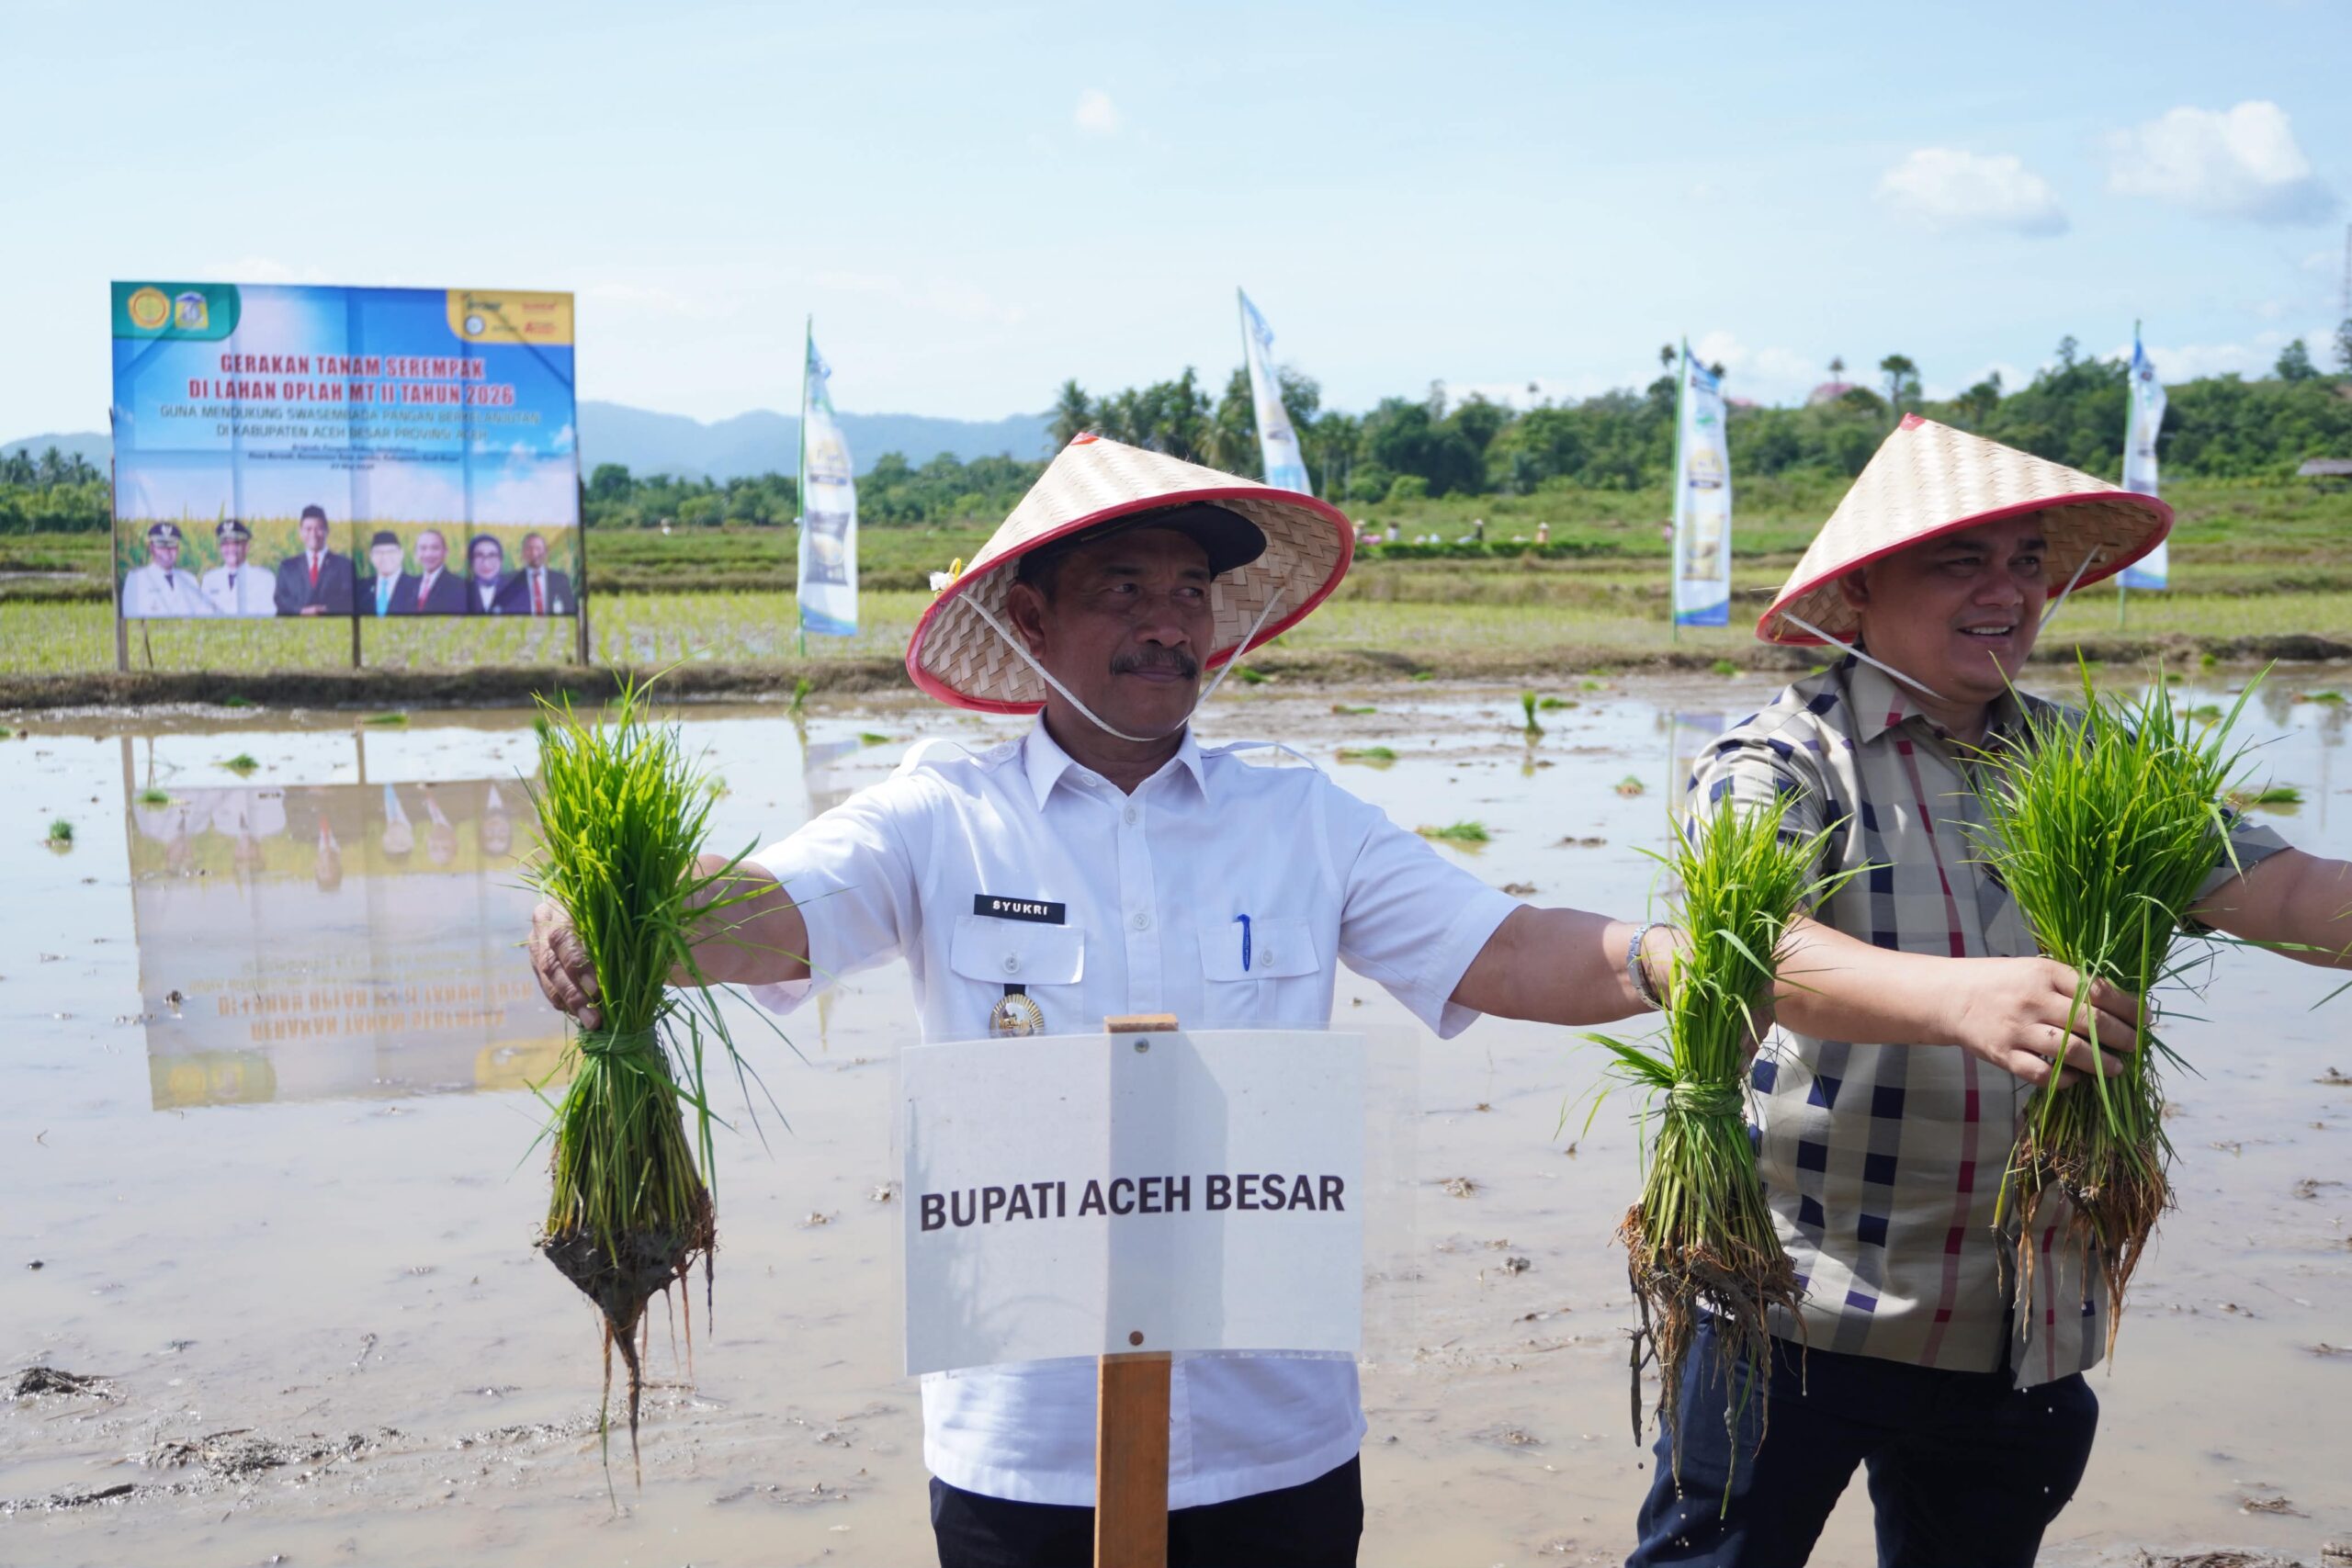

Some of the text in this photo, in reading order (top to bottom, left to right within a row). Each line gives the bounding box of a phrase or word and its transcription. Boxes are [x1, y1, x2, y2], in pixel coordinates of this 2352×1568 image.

[220, 354, 485, 378] GERAKAN TANAM SEREMPAK
[189, 378, 514, 405] DI LAHAN OPLAH MT II TAHUN 2026
[160, 404, 197, 418] GUNA
[201, 405, 283, 420] MENDUKUNG
[287, 407, 378, 422] SWASEMBADA
[382, 410, 435, 423] PANGAN
[216, 423, 487, 442] DI KABUPATEN ACEH BESAR PROVINSI ACEH
[992, 899, 1049, 916] SYUKRI
[920, 1174, 1345, 1232] BUPATI ACEH BESAR
